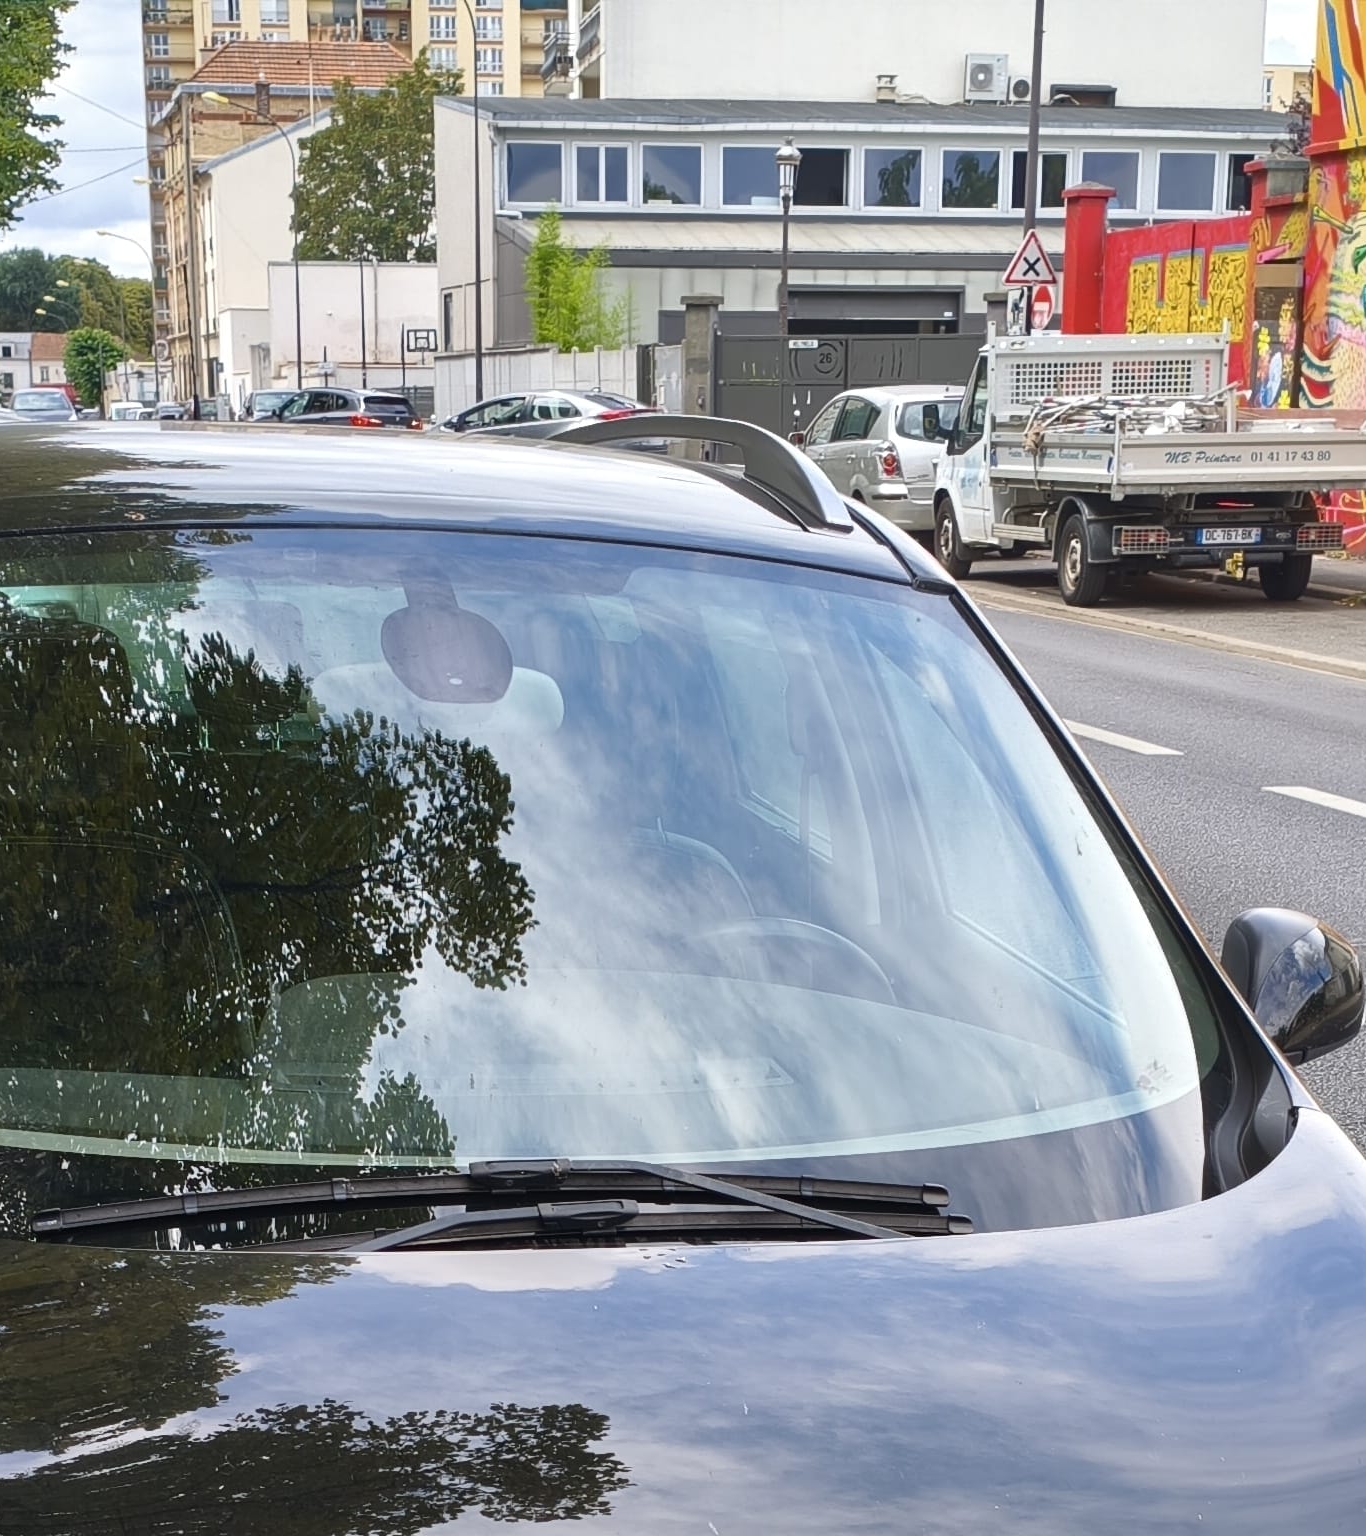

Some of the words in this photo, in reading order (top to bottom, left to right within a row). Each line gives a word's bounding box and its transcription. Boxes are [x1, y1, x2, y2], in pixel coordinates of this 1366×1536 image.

[819, 353, 832, 364] 26
[1164, 451, 1192, 464] MB
[1195, 451, 1242, 464] Peinture
[1250, 452, 1263, 462] 01
[1267, 452, 1280, 462] 41
[1285, 451, 1297, 462] 17
[1301, 451, 1314, 461] 43
[1317, 450, 1331, 461] 80
